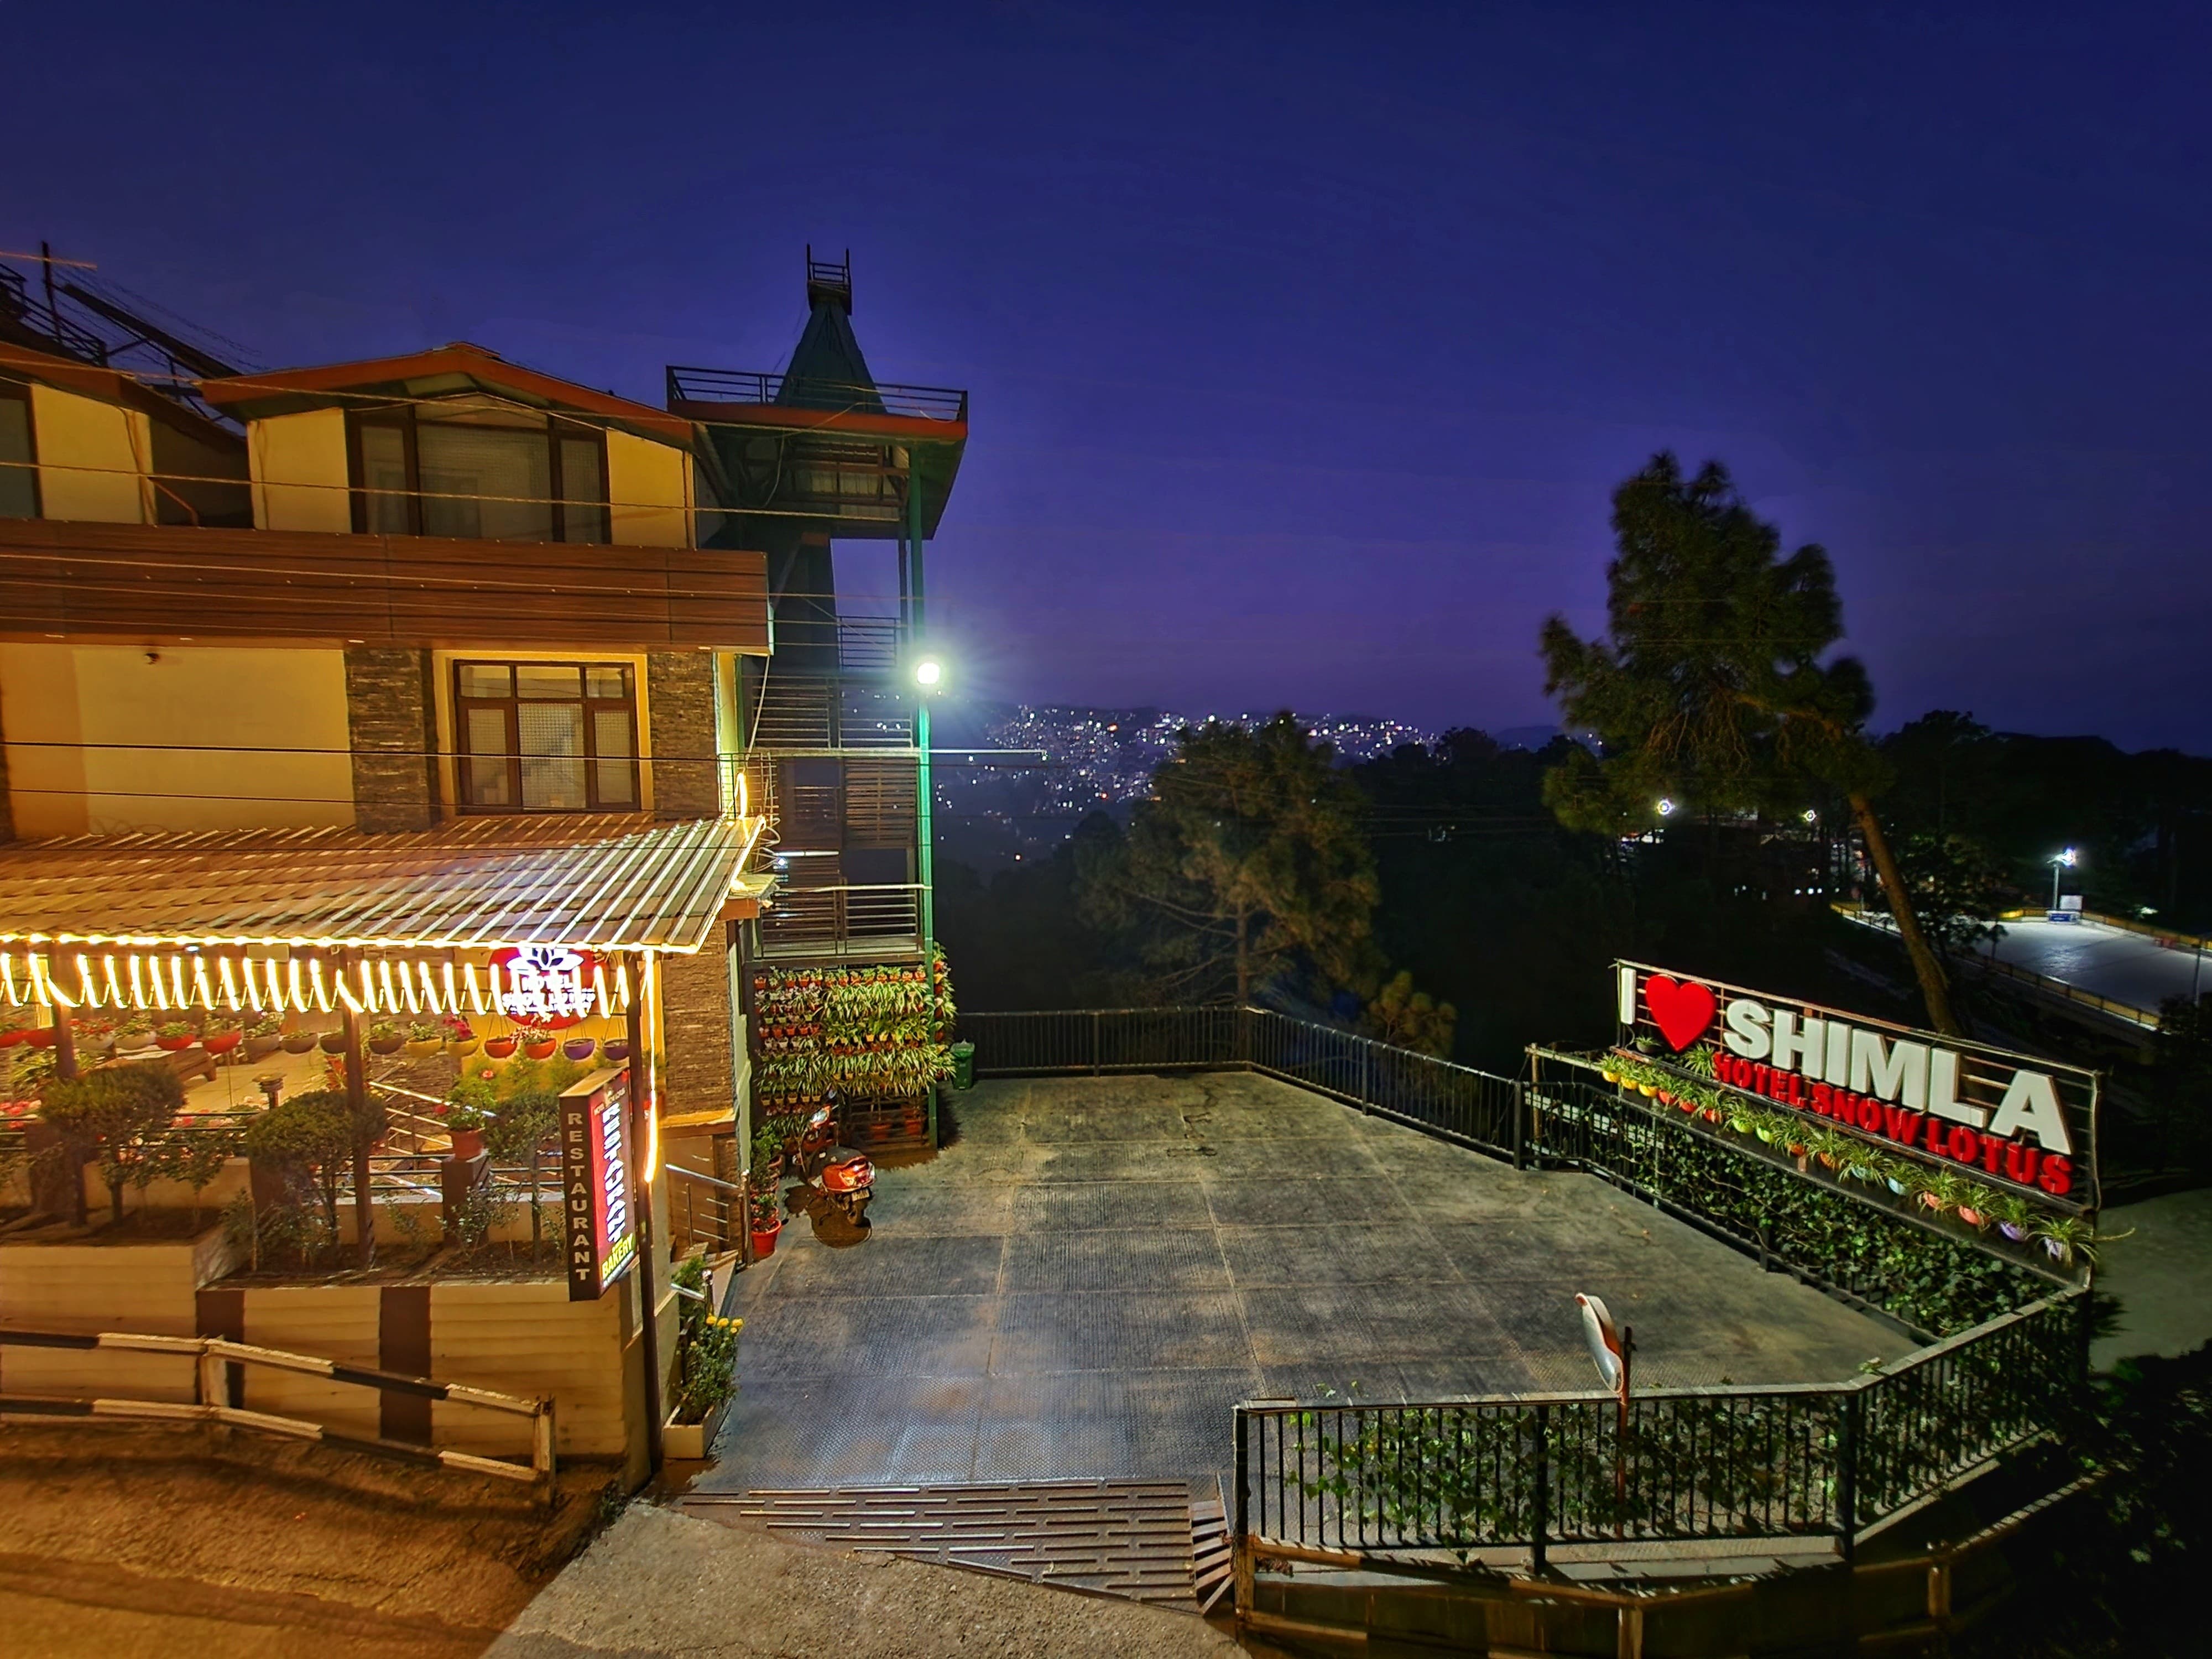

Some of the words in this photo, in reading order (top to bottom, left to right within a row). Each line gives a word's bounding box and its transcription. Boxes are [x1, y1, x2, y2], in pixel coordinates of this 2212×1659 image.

[1620, 967, 1637, 1025] I
[1724, 999, 2072, 1156] SHIMLA
[1713, 1051, 1807, 1110] HOTEL
[1810, 1082, 1922, 1146] SNOW
[1926, 1117, 2074, 1195] LOTUS
[568, 1113, 590, 1281] RESTAURANT
[602, 1103, 626, 1243] RESTAURANT
[602, 1233, 633, 1280] BAKERY
